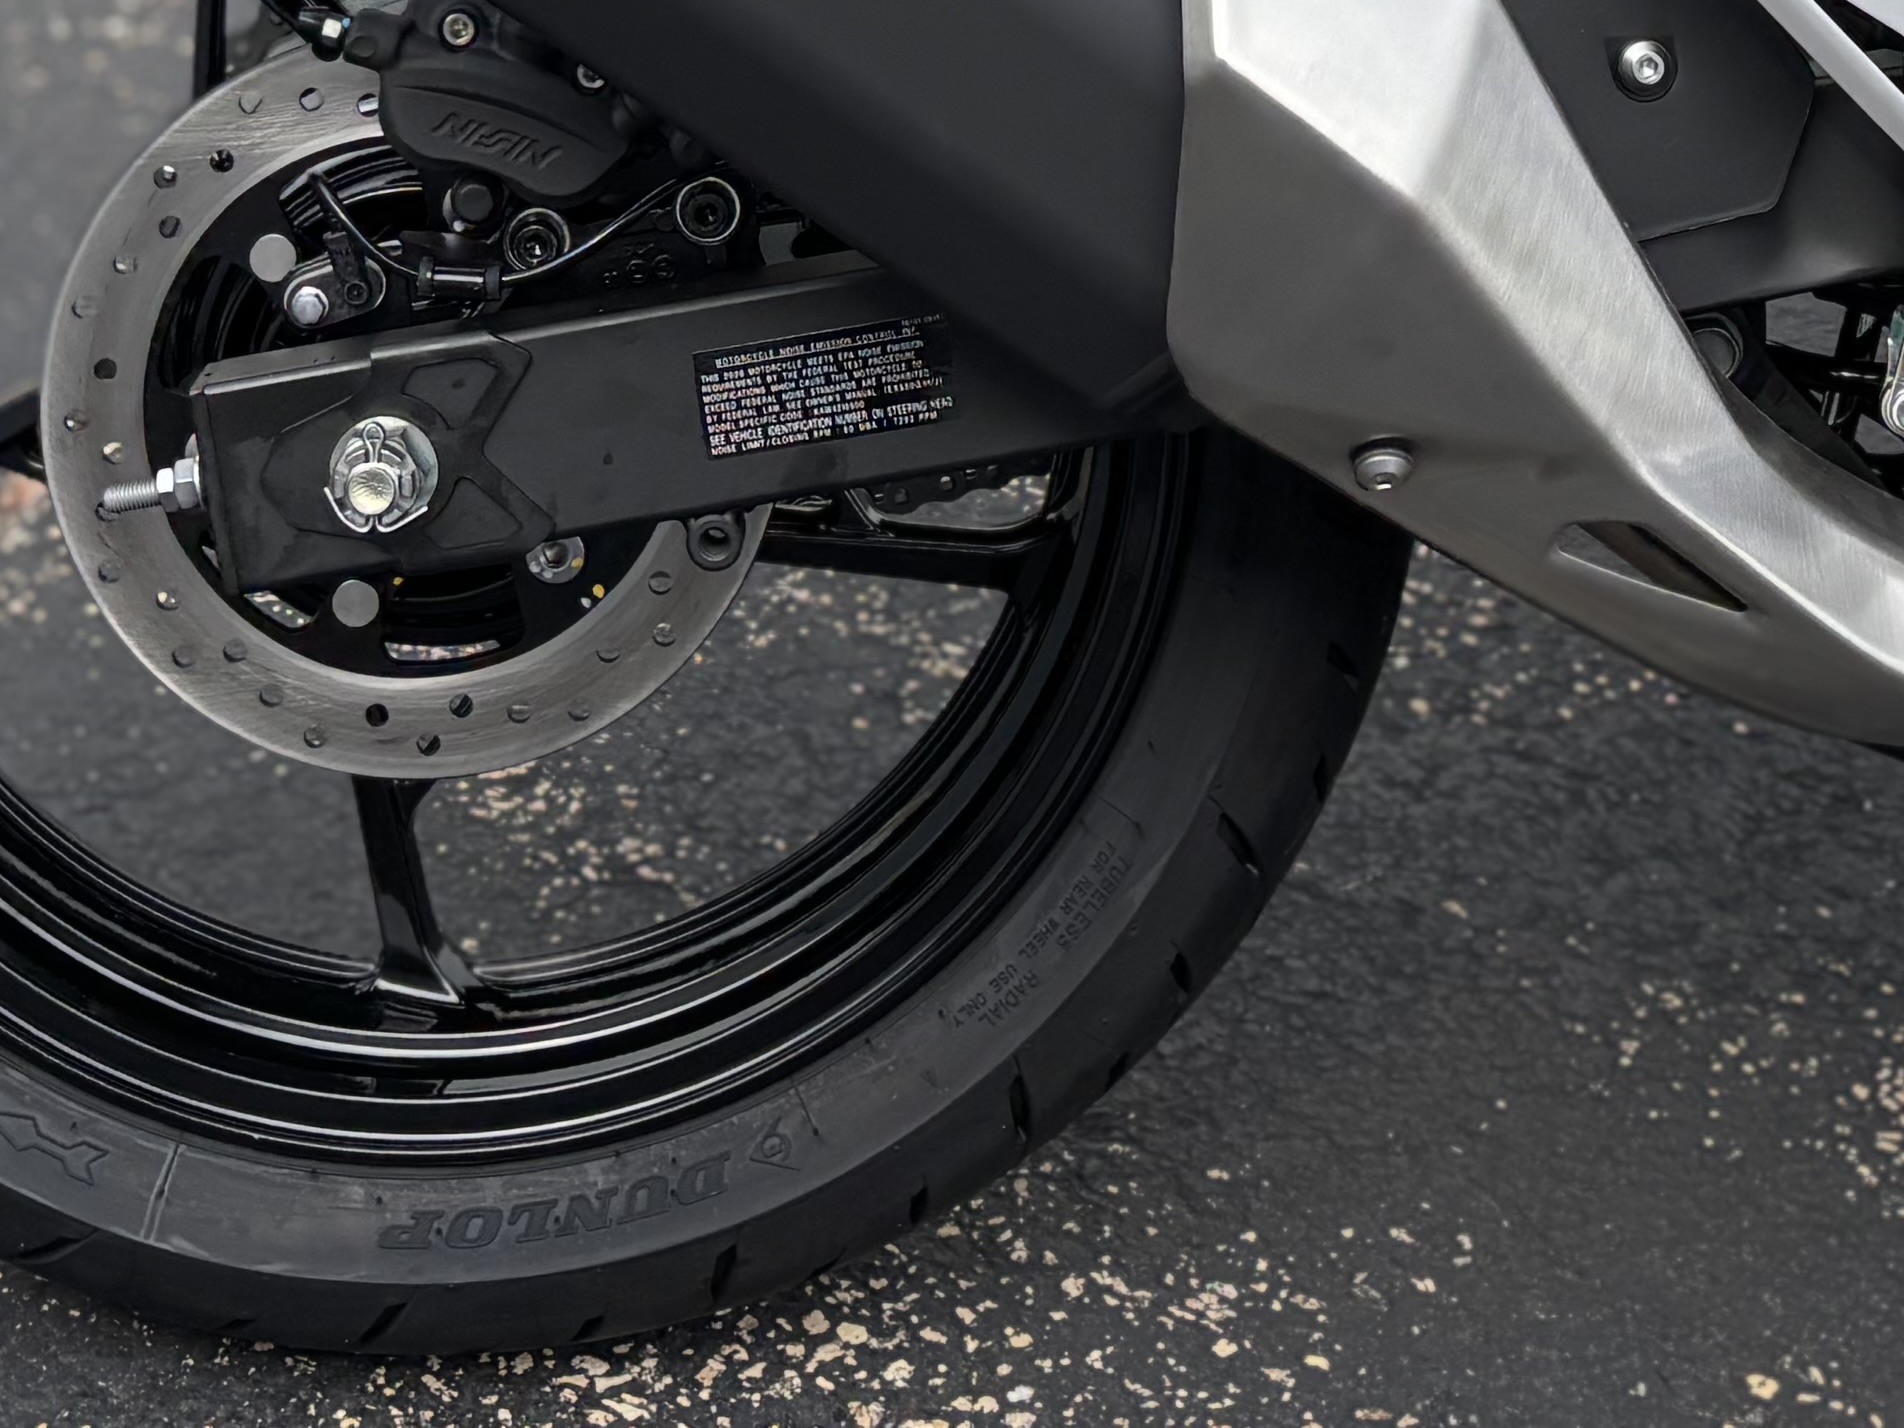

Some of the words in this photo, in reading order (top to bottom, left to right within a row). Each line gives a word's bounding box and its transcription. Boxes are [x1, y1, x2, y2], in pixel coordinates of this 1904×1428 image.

[747, 359, 802, 376] MOTORCYCLE
[781, 369, 797, 380] THE
[801, 363, 838, 377] FEDERAL
[842, 359, 863, 370] TEST
[702, 385, 766, 403] MODIFICATIONS
[704, 400, 737, 413] EXCEED
[740, 393, 776, 407] FEDERAL
[861, 377, 876, 388] ARE
[705, 413, 718, 423] BY
[721, 407, 757, 421] FEDERAL
[709, 433, 726, 446] SEE
[728, 427, 764, 443] VEHICLE
[767, 415, 833, 437] IDENTIFICATION
[833, 409, 869, 425] NUMBER
[886, 400, 928, 417] STEERING
[738, 414, 778, 428] SPECIFIC
[710, 443, 736, 456] NOISE
[1092, 841, 1116, 876] FOR
[1058, 857, 1133, 951] TUBELESS
[1060, 876, 1095, 915] REAR
[1017, 915, 1061, 960] WHEEL
[989, 963, 1021, 995] USE
[952, 993, 988, 1029] ONLY
[978, 970, 1040, 1028] RADIAL
[377, 1150, 730, 1250] DUNLOP
